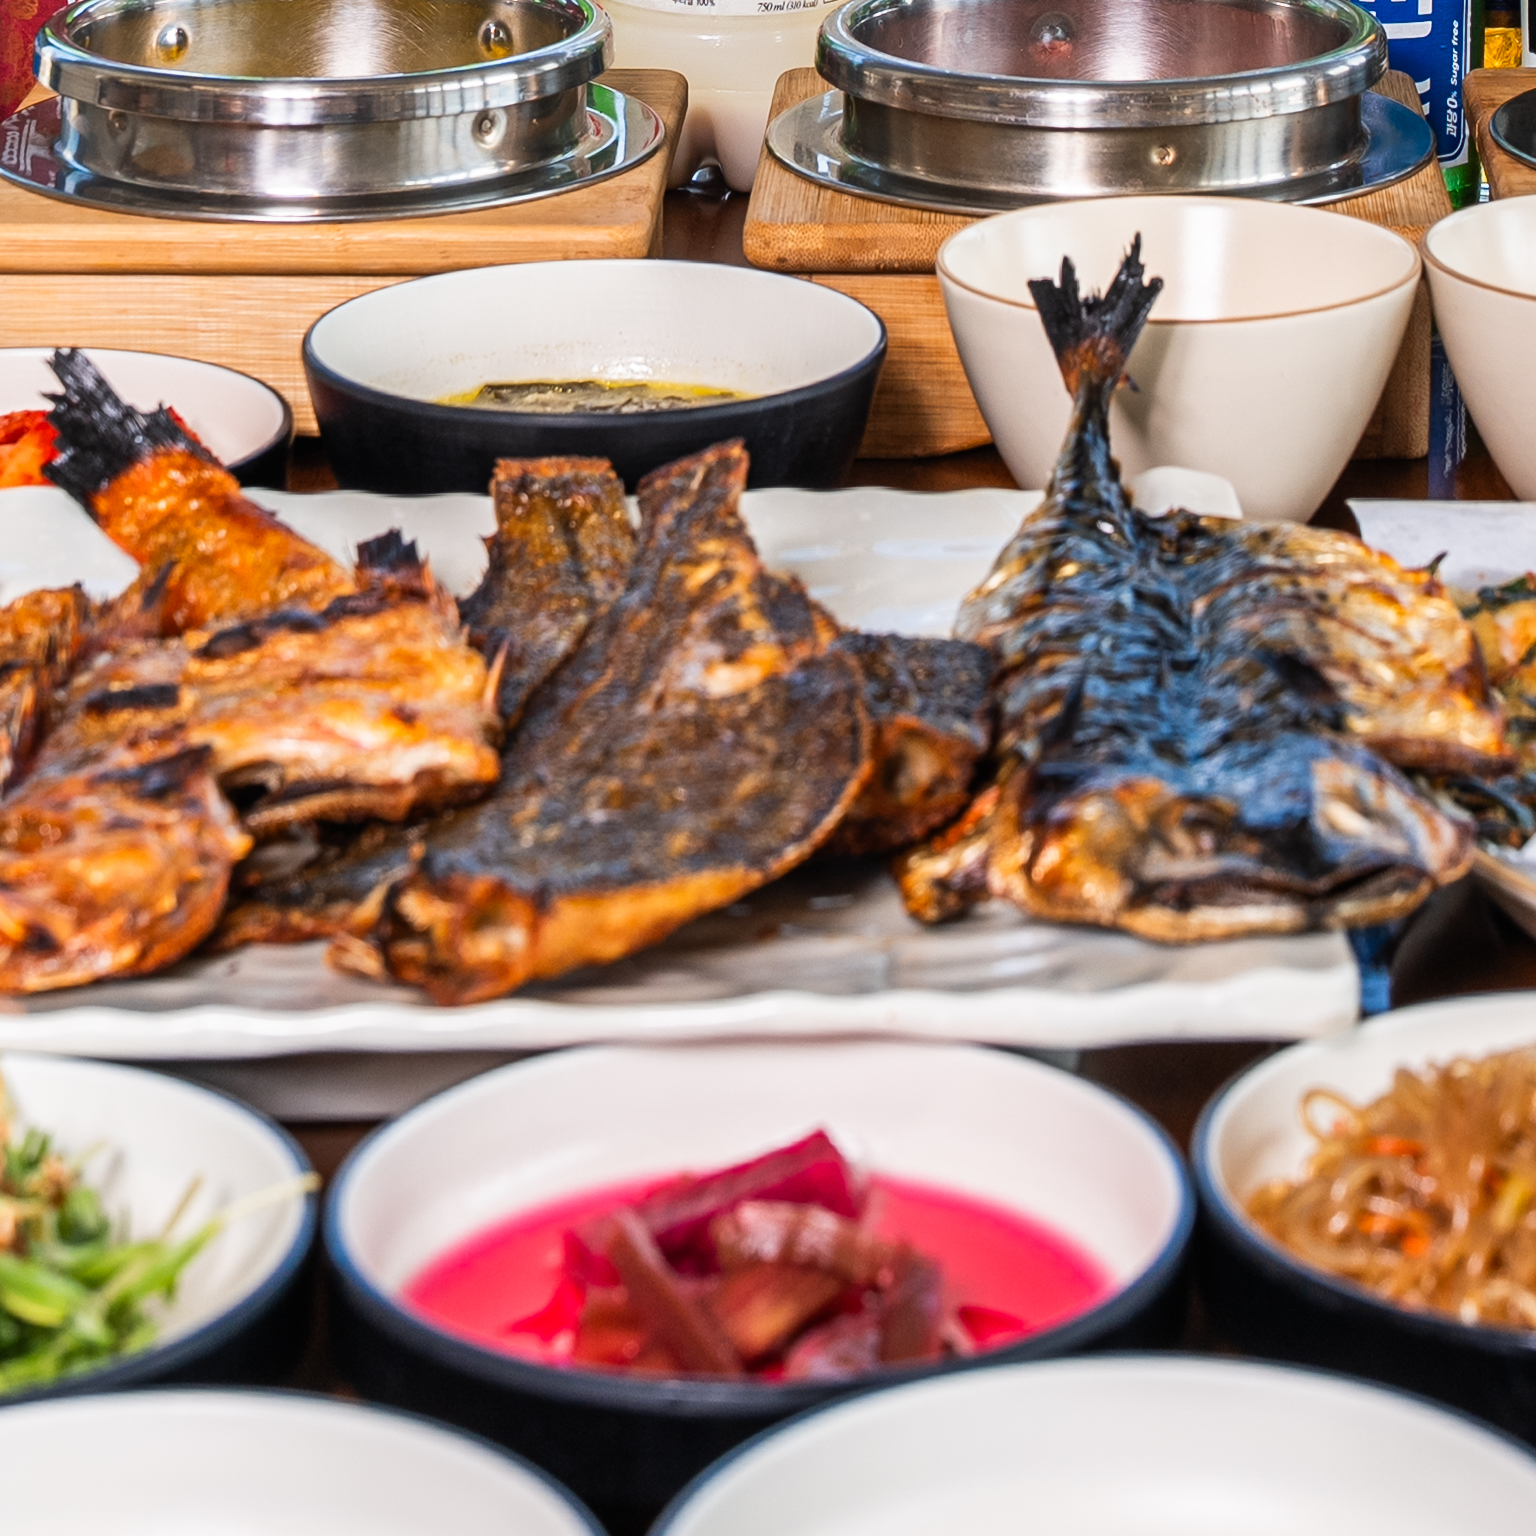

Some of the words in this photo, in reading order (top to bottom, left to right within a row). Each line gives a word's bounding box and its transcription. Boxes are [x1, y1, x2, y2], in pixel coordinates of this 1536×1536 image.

[757, 2, 773, 13] 750
[773, 1, 785, 11] ml
[1450, 19, 1460, 47] free
[1450, 47, 1460, 87] Sugar
